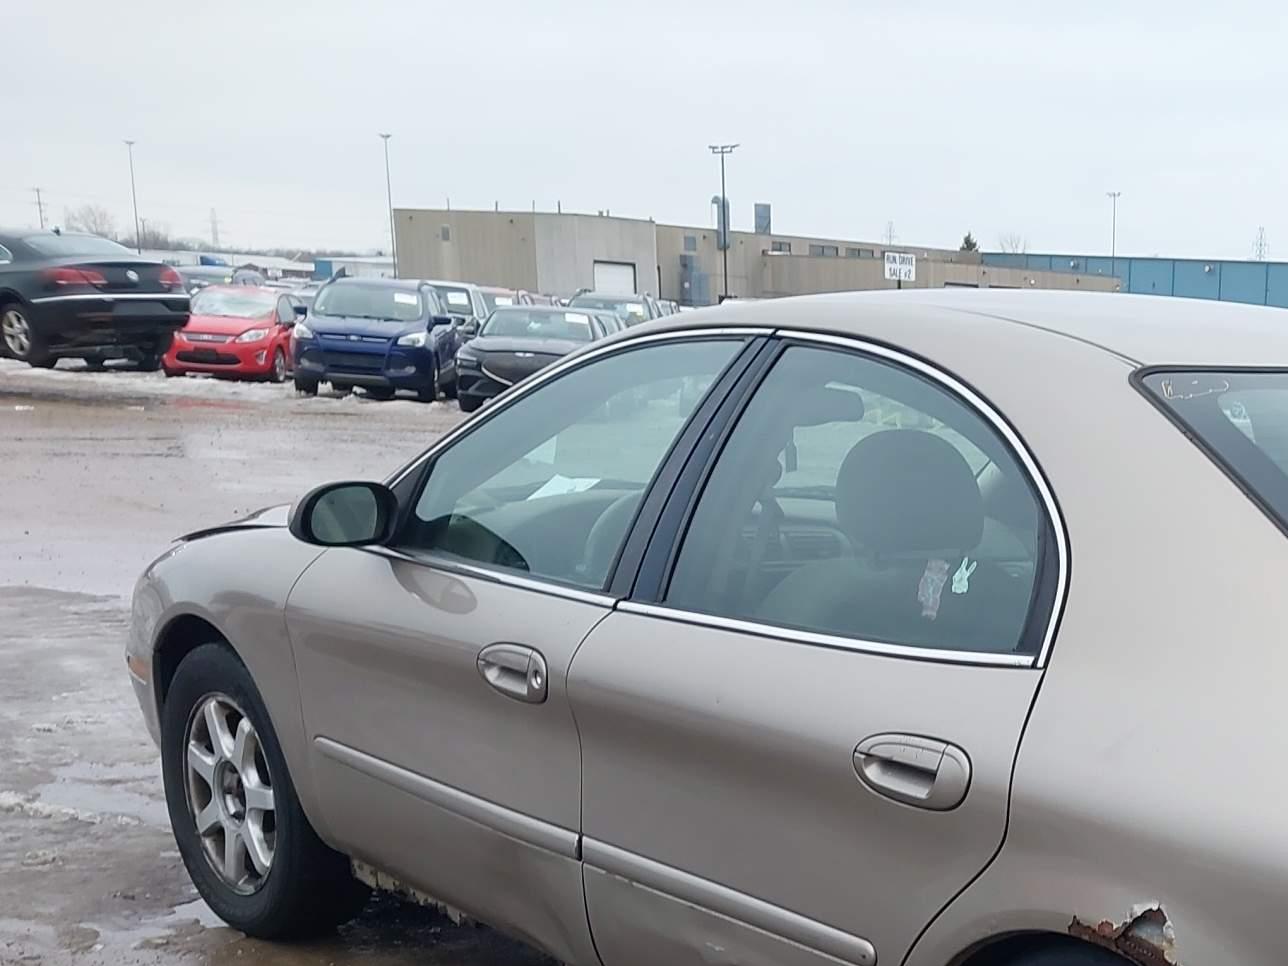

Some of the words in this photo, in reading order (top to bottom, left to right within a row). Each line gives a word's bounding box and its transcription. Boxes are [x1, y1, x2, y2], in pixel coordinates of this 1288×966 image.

[886, 254, 897, 265] RUN
[899, 255, 914, 266] DRIVE
[888, 267, 902, 278] SALE
